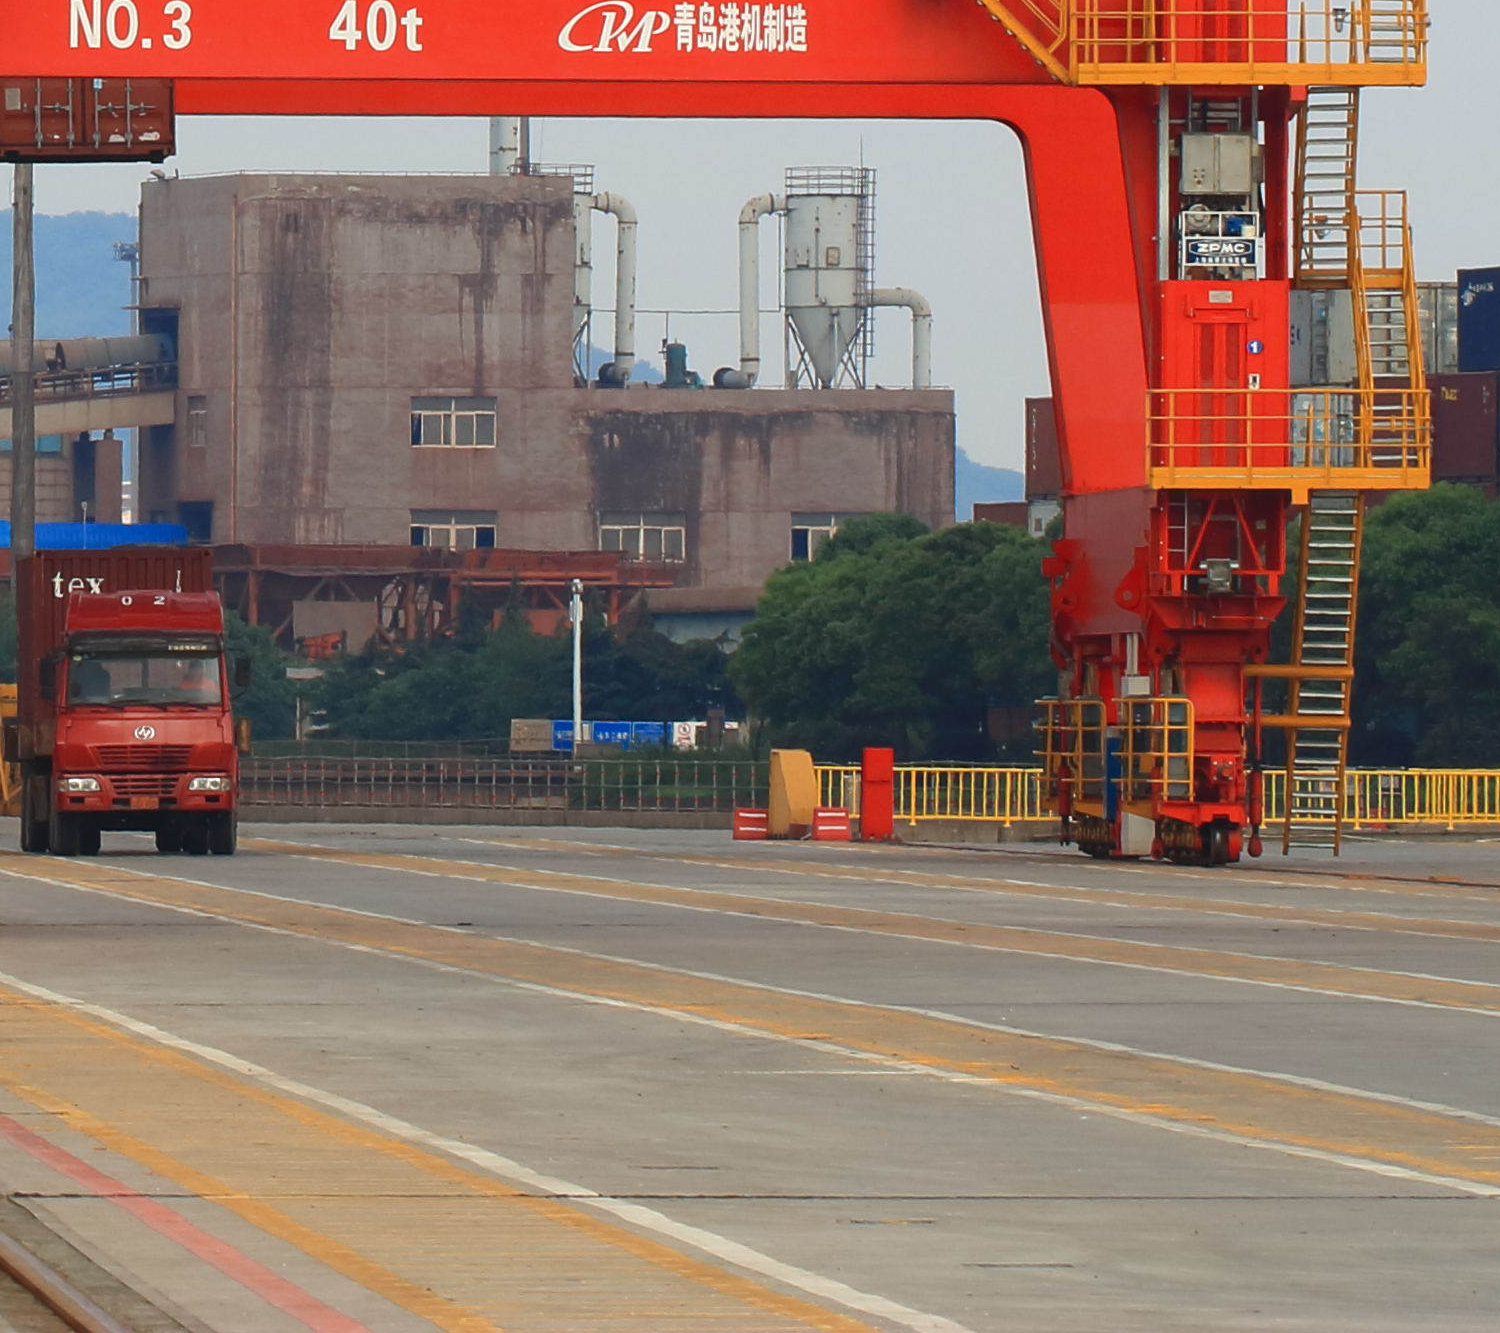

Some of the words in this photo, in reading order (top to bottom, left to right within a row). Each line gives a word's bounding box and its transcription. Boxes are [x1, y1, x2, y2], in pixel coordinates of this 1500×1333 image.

[673, 1, 808, 54] 青岛港机制造
[1197, 243, 1245, 253] ZPMC
[52, 571, 104, 598] tex
